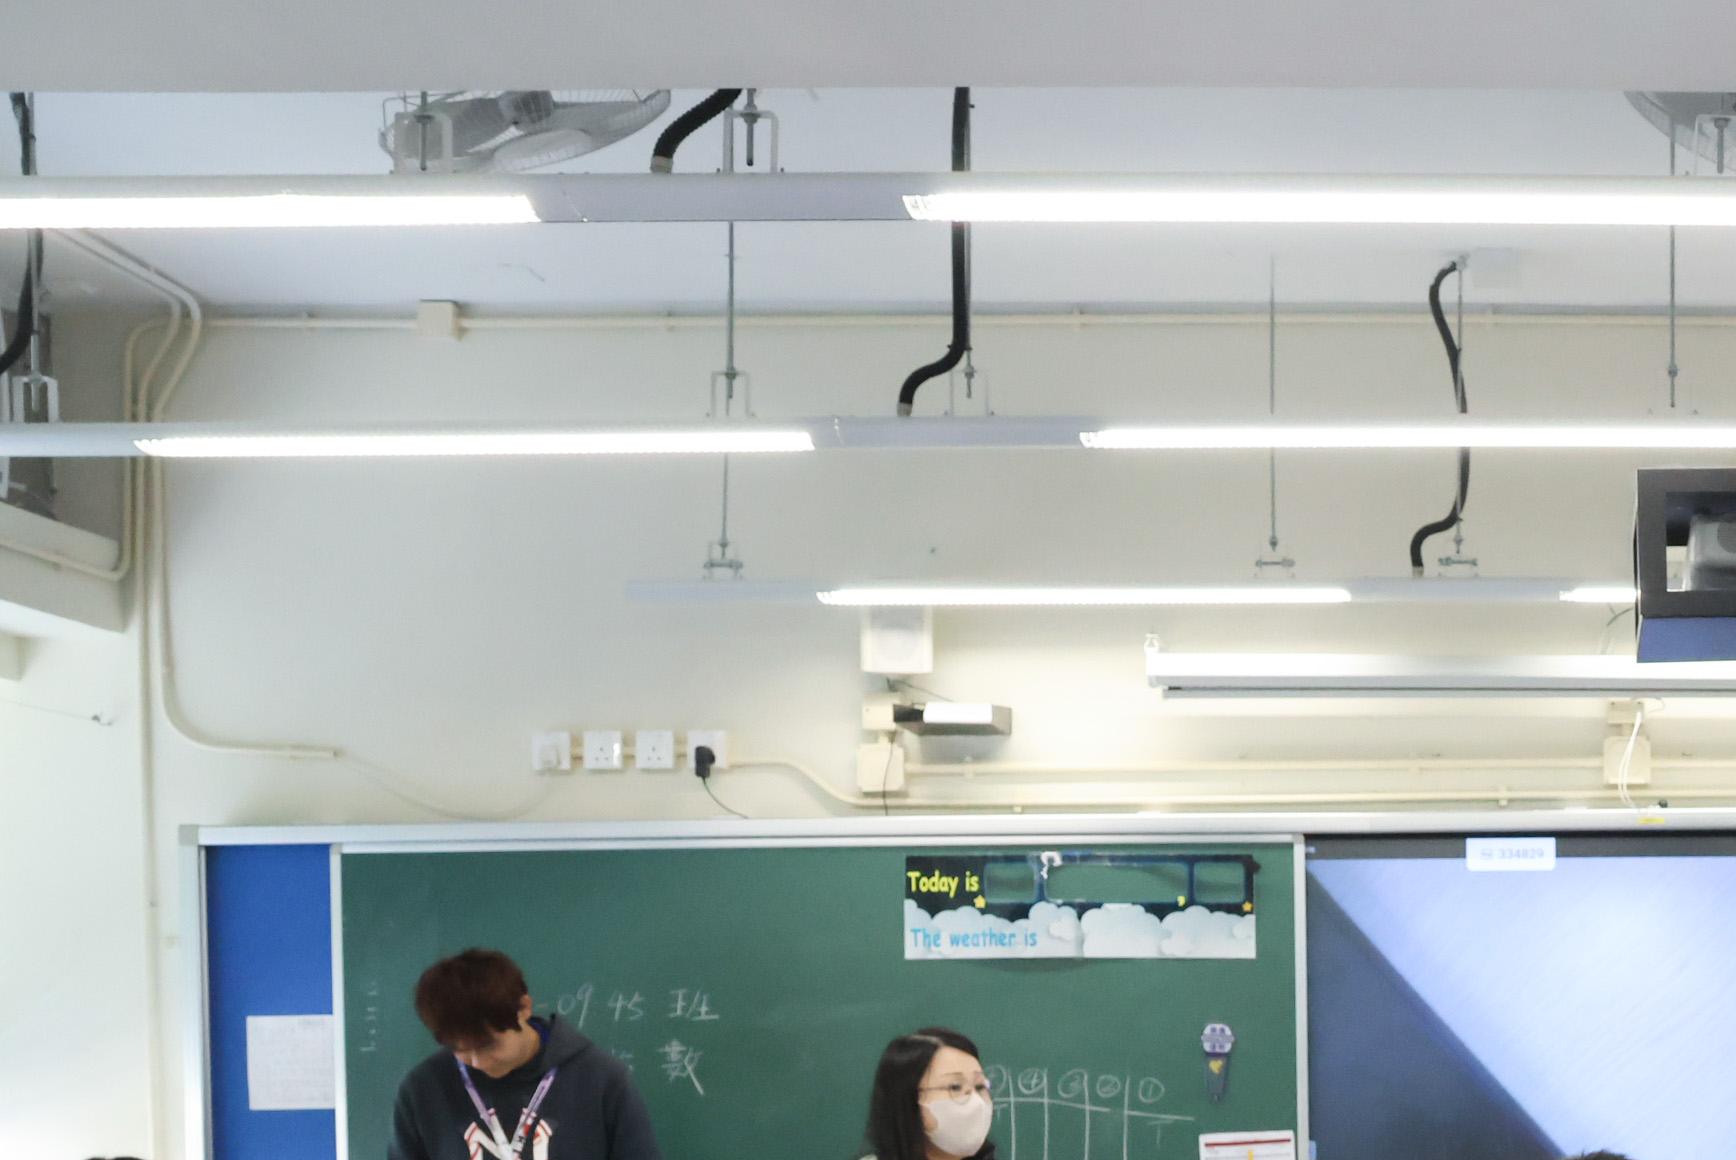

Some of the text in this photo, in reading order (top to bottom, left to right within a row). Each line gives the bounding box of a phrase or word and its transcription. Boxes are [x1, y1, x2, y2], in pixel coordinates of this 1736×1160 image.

[907, 870, 980, 898] Today is
[911, 927, 1038, 948] The weather is
